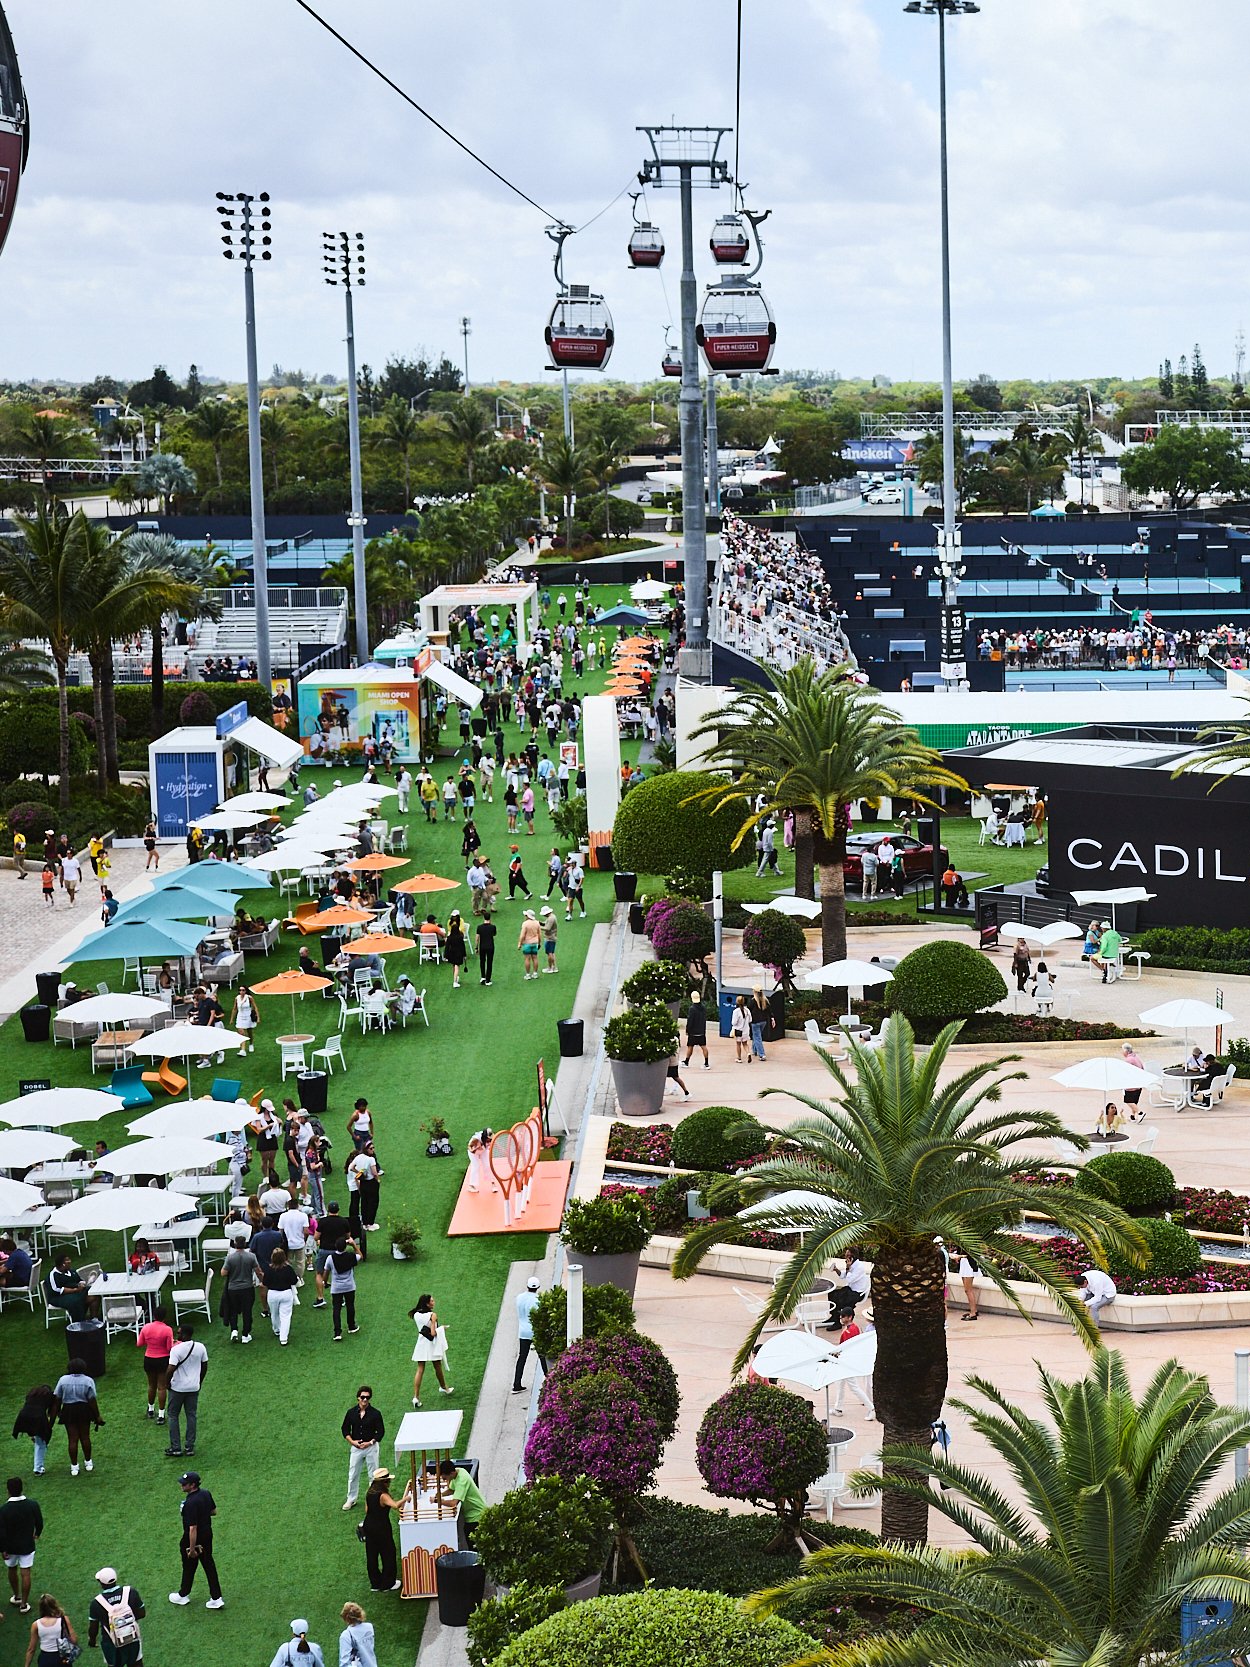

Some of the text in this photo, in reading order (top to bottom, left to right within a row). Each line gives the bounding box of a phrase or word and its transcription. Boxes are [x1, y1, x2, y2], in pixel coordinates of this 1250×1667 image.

[840, 448, 893, 459] eineken
[951, 616, 962, 627] 13
[166, 782, 207, 792] Hydration
